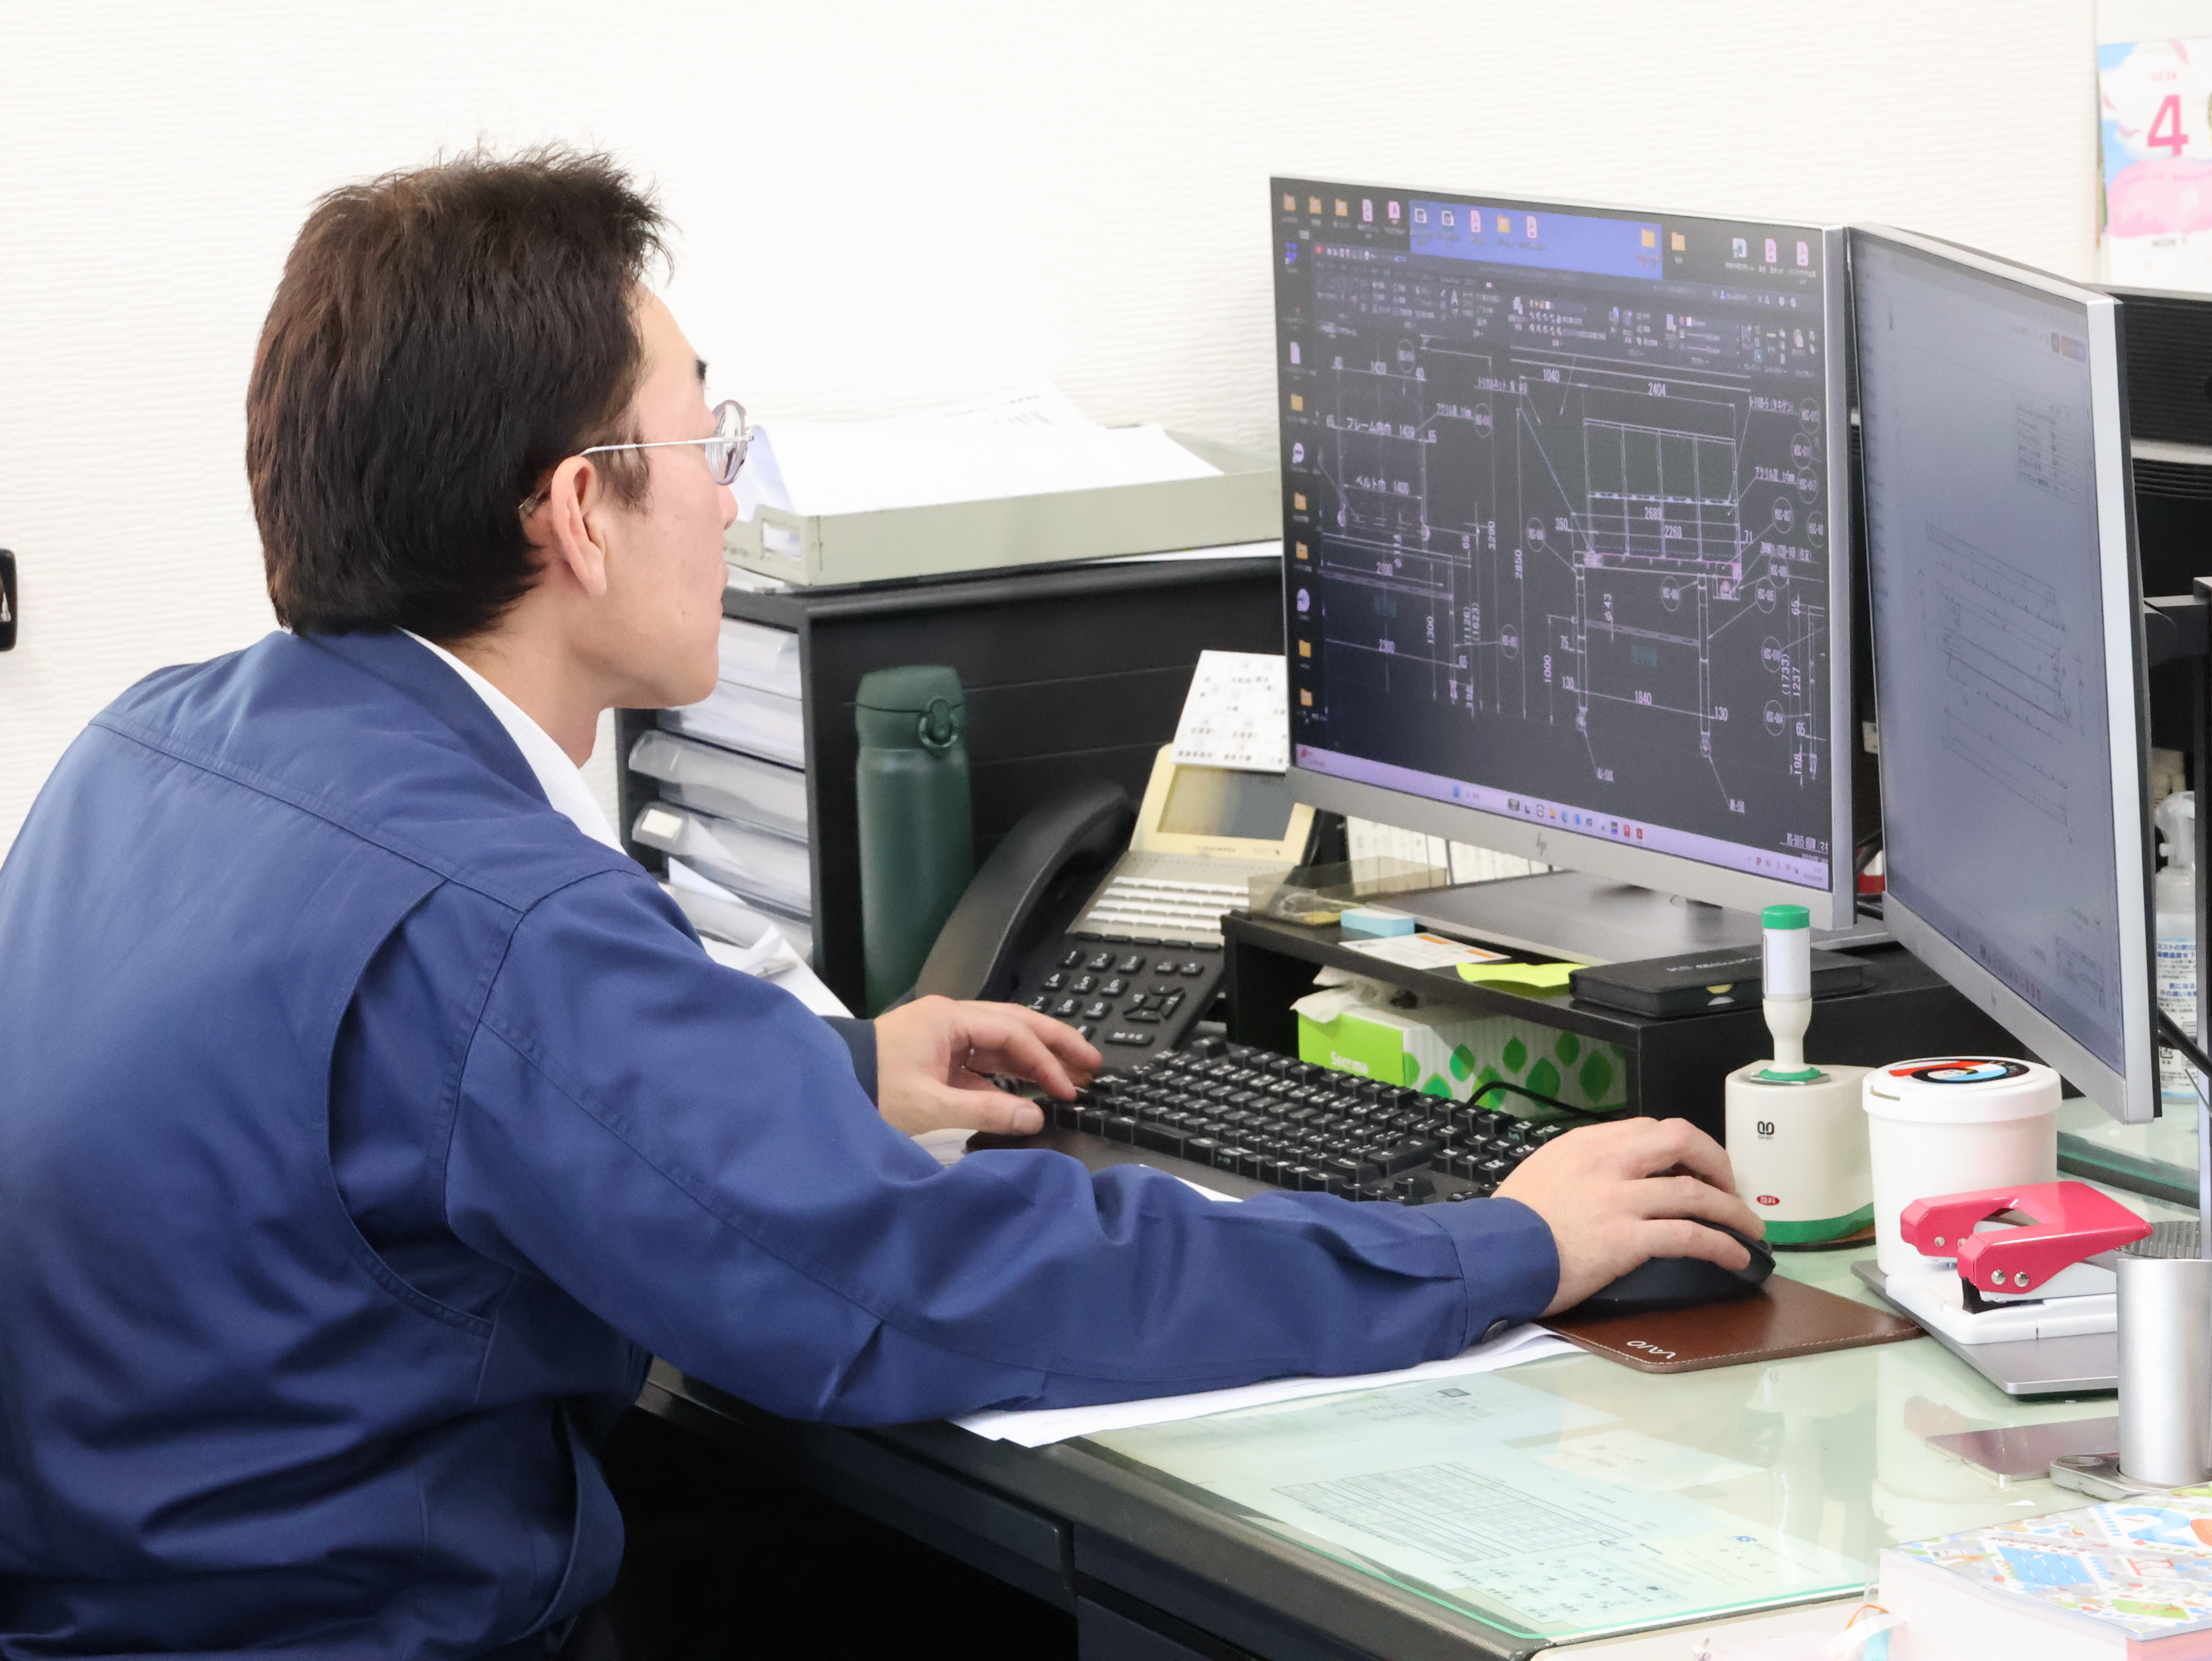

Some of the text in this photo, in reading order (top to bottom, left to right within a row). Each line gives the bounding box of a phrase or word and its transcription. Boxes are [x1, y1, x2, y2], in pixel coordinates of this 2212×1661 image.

[2147, 94, 2189, 156] 4
[1648, 382, 1666, 397] 2404
[1665, 525, 1683, 539] 2268
[1744, 529, 1753, 543] 71
[1543, 654, 1551, 683] 1000
[1781, 654, 1790, 695] (1733)
[1792, 667, 1801, 696] 1237
[1635, 691, 1652, 705] 1840
[1715, 706, 1728, 721] 130
[1794, 753, 1802, 775] 198
[1537, 832, 1548, 855] hp
[1626, 1340, 1676, 1360] VAIO
